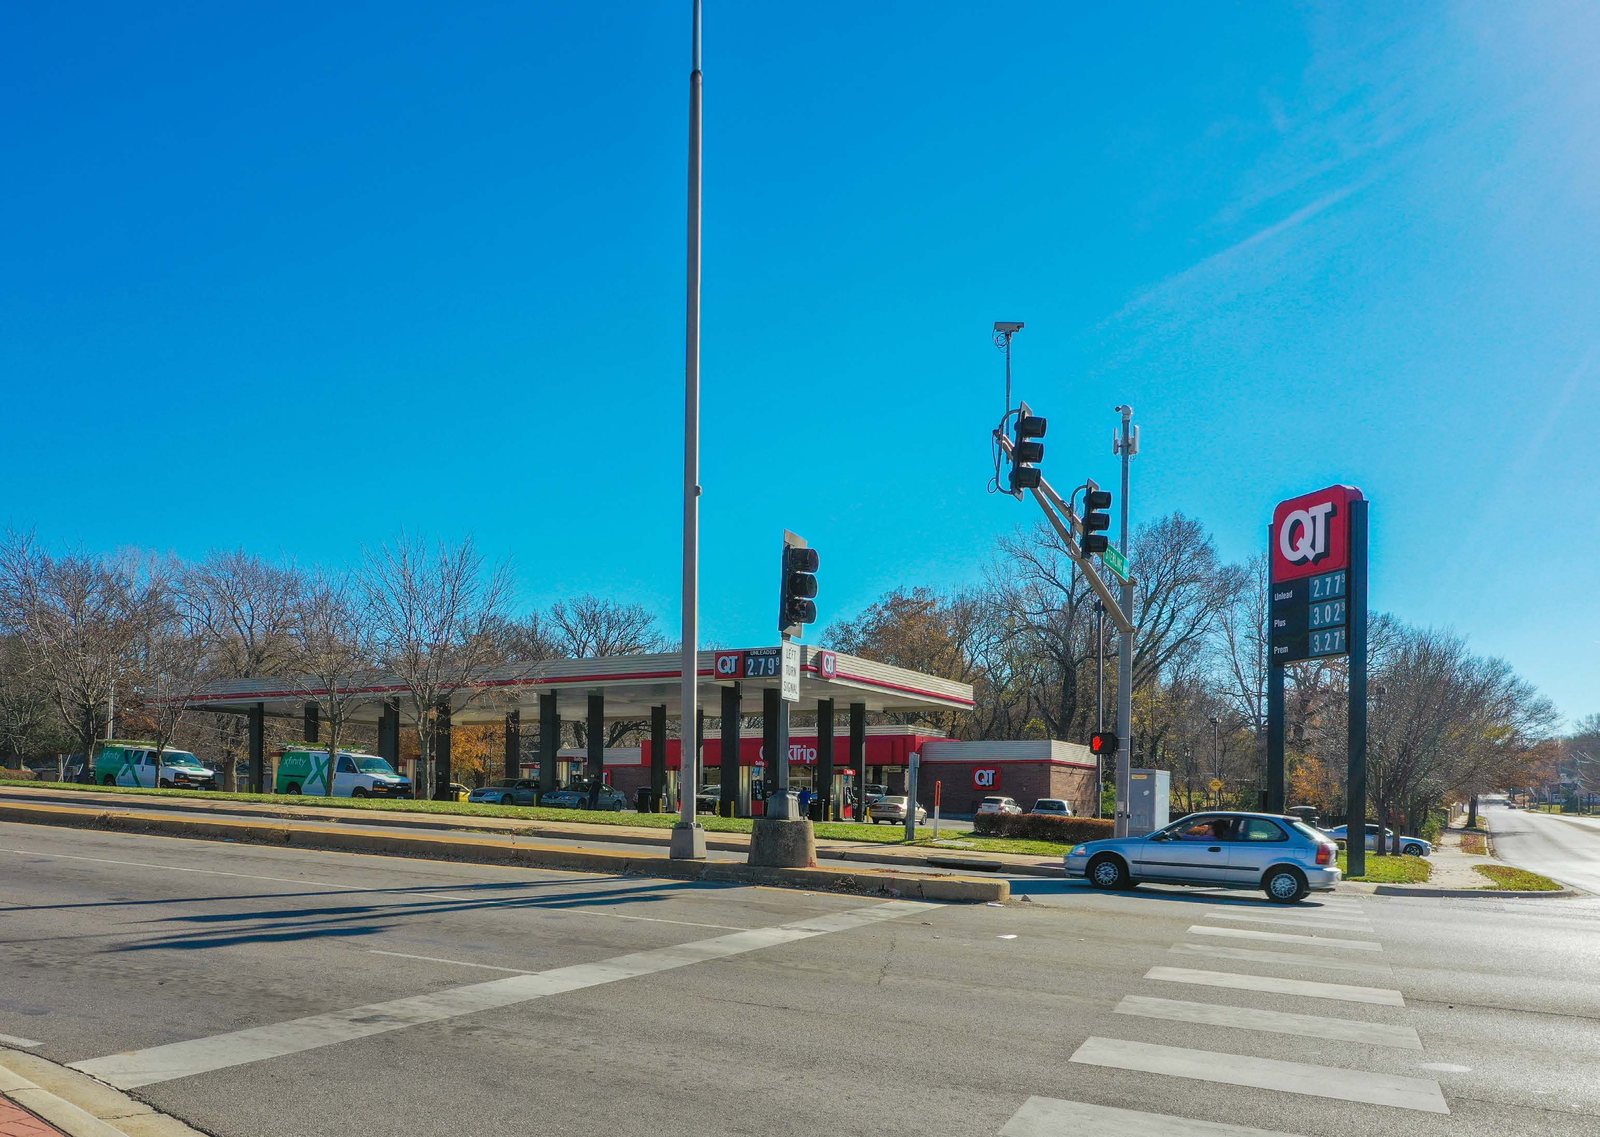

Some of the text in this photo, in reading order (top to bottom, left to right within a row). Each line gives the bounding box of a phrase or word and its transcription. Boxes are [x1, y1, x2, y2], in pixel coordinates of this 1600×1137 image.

[1279, 501, 1333, 562] QT
[1274, 590, 1293, 601] Unlead
[1274, 618, 1287, 628] Plus
[785, 647, 797, 661] LEFT
[1273, 646, 1289, 654] Prem
[717, 656, 738, 674] QT
[785, 664, 797, 678] TURN
[823, 654, 835, 674] QT
[783, 680, 798, 695] SIGNAL
[283, 756, 307, 767] xfinity
[974, 769, 996, 787] QT
